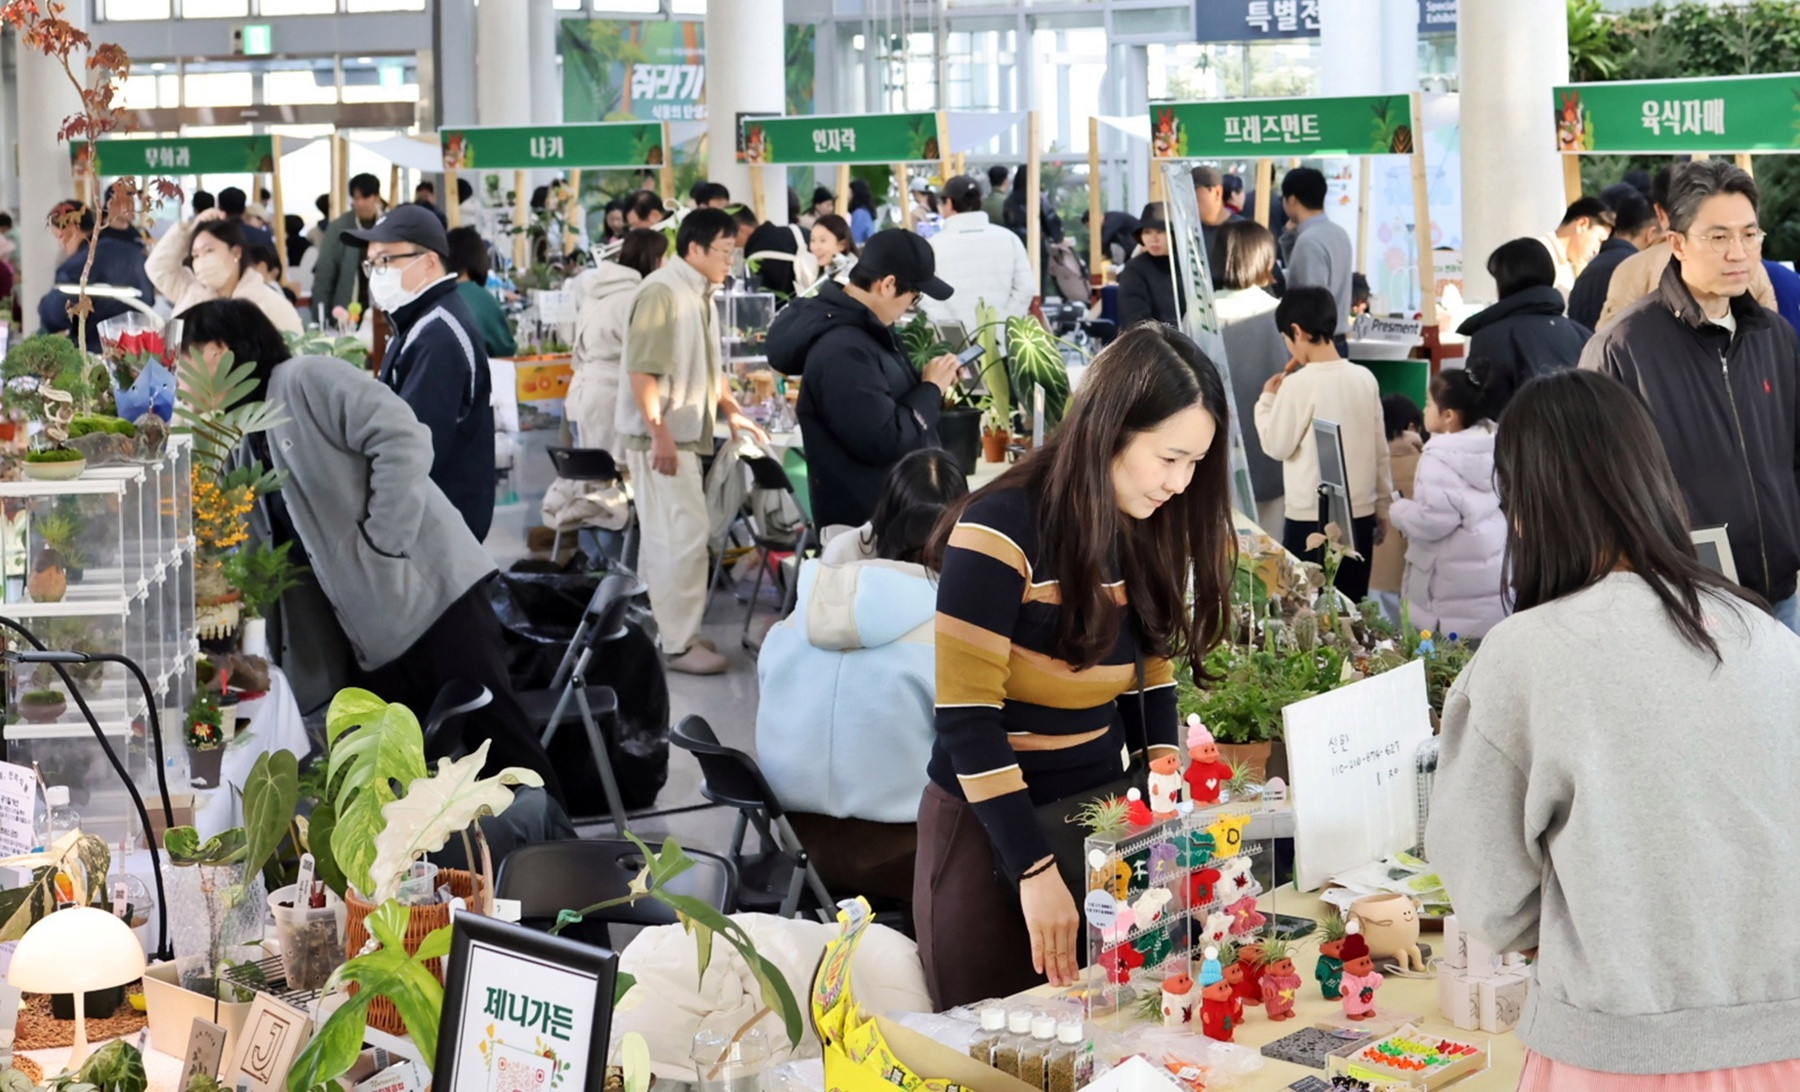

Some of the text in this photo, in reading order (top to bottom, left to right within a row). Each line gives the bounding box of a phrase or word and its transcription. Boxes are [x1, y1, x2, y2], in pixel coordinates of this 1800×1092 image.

[632, 63, 705, 100] 쥐라기
[1224, 113, 1321, 144] 프레즈먼트
[1641, 98, 1725, 136] 육식자매
[530, 135, 564, 159] 나키
[1371, 318, 1420, 335] Presment
[484, 986, 574, 1042] 제니가든
